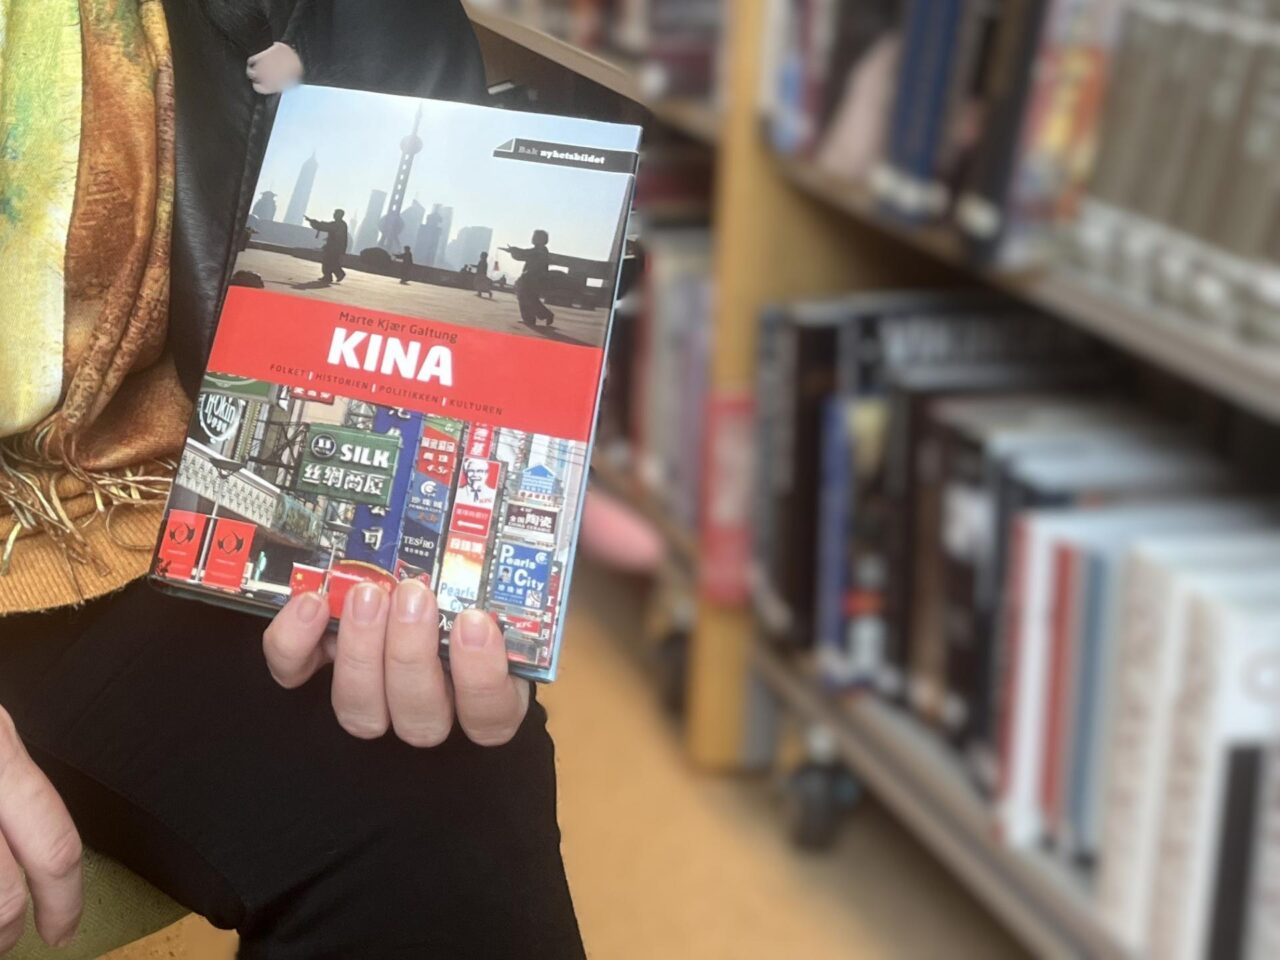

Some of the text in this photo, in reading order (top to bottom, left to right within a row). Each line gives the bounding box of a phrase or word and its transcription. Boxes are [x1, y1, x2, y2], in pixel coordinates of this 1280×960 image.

[518, 146, 605, 165] Bak nyhetsbildet
[338, 311, 458, 344] Marte Kjær Galtung
[327, 327, 453, 387] KINA
[270, 363, 503, 416] FOLKET HISTORIEN POLITIKKEN KULTUREN
[340, 443, 390, 468] SILK
[500, 544, 536, 570] Pearls
[440, 582, 476, 598] Pearls
[514, 568, 545, 591] City
